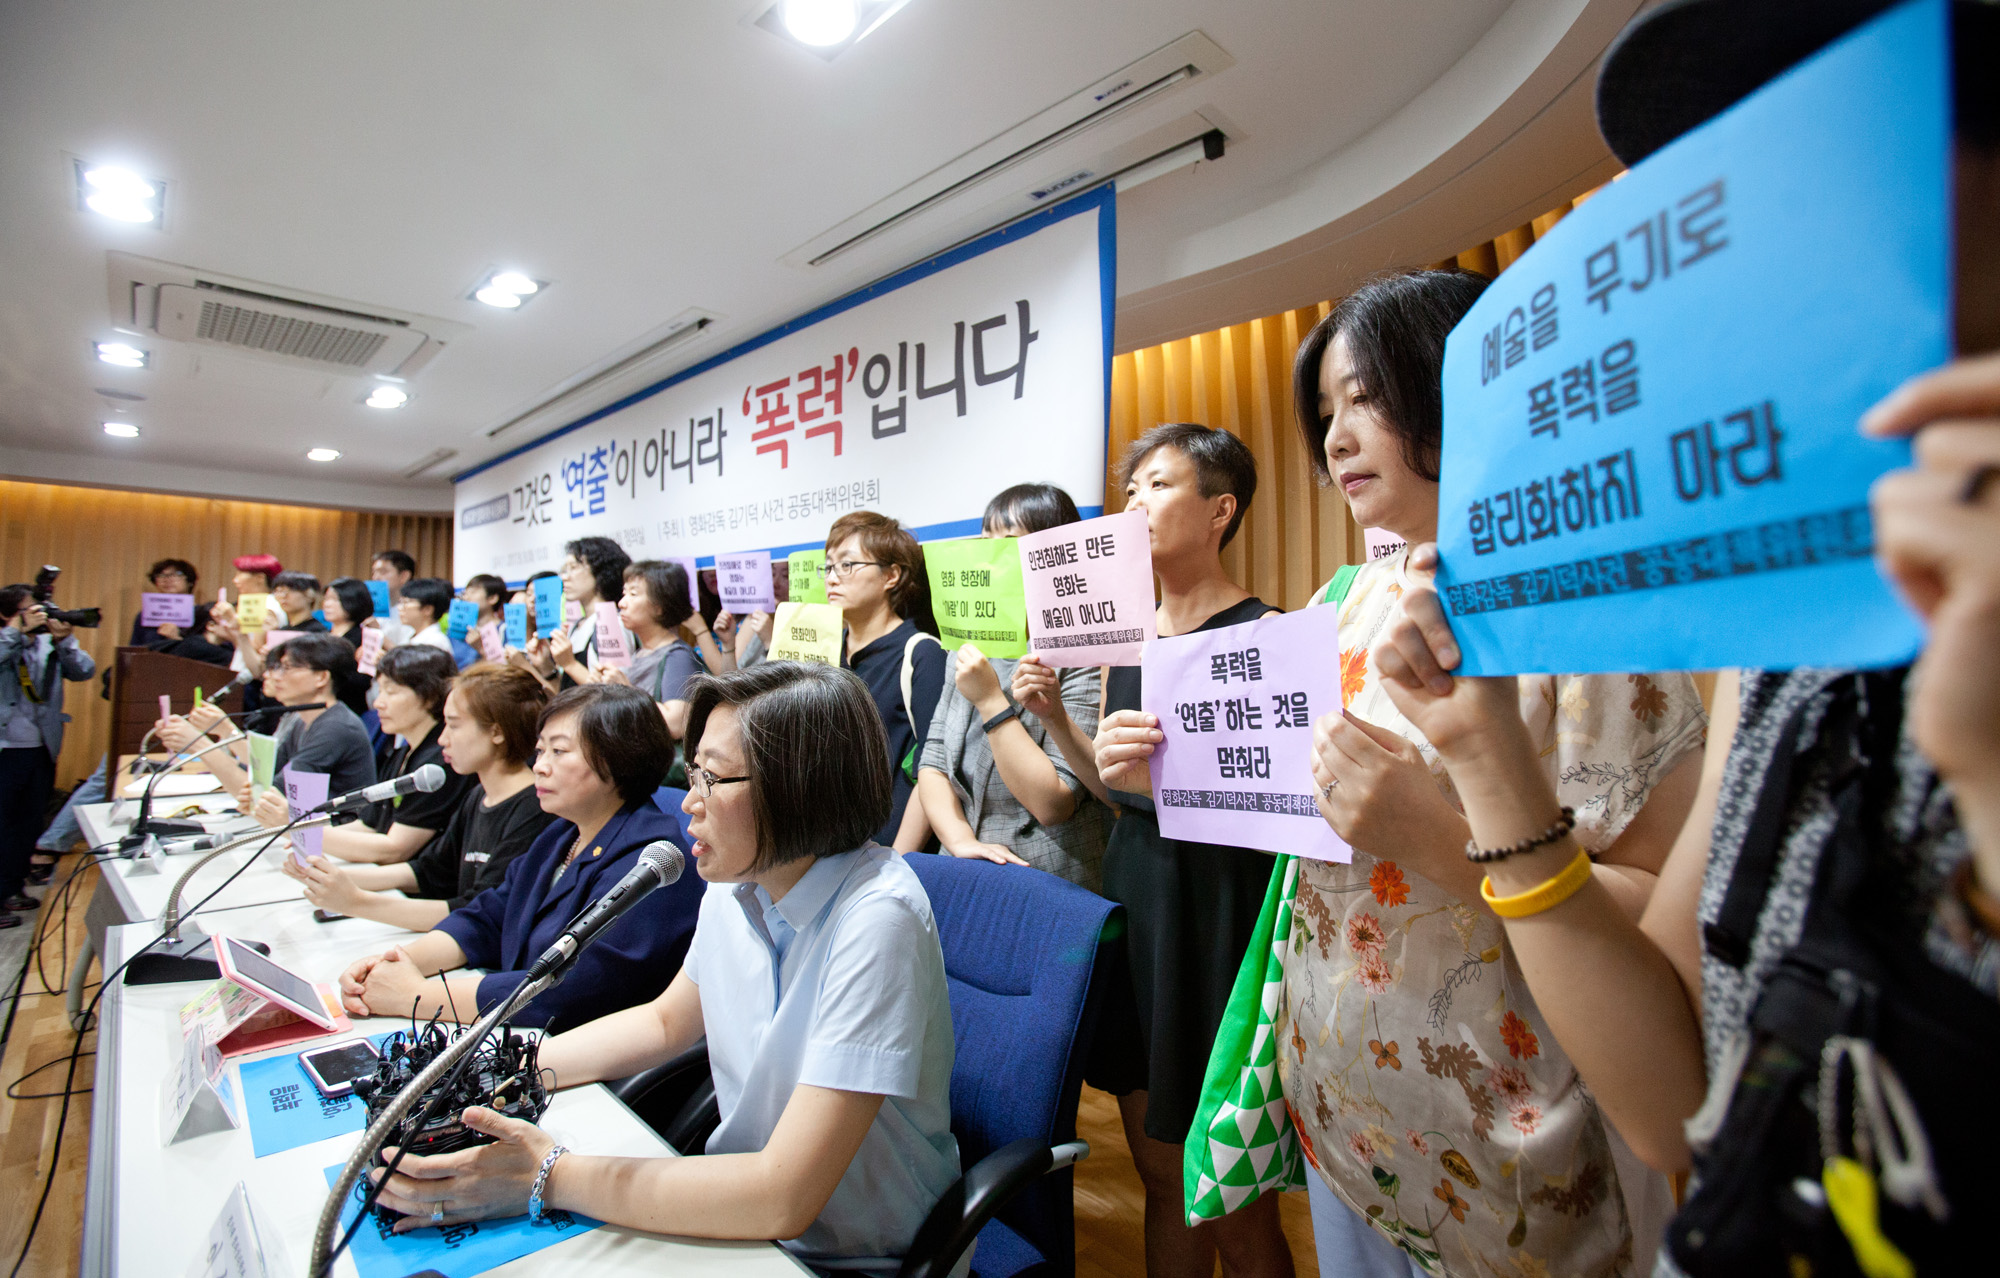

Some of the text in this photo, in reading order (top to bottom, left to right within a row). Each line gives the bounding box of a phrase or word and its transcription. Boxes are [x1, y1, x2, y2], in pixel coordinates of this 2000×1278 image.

[1481, 176, 1731, 387] 예술을 무기로
[1527, 337, 1641, 439] 폭력을
[512, 473, 553, 528] 그것은
[561, 438, 636, 520] ‘연출’이
[643, 407, 727, 491] 아니라
[742, 299, 1040, 469] ‘폭력’입니다
[1467, 400, 1786, 556] 합리화하지 마라
[688, 509, 725, 537] 영화감독
[728, 500, 759, 531] 김기덕
[761, 498, 784, 523] 사건
[787, 478, 881, 520] 공동대책위원회
[1028, 534, 1115, 571] 인권침해로 만든
[941, 570, 990, 587] 영화 현장에
[1052, 573, 1088, 597] 영화는
[1447, 577, 1514, 616] 영화감독
[1519, 556, 1632, 604] 김기덕사건
[975, 600, 996, 618] 있다
[1042, 600, 1116, 629] 예술이 아니다
[791, 626, 818, 642] 영화인의
[1091, 628, 1144, 645] 공동대책위원회
[1210, 647, 1263, 684] 폭력을
[1174, 691, 1309, 733] ‘연출’하는 것을
[1217, 746, 1271, 779] 멈춰라
[1162, 789, 1321, 817] 영화감독 김기덕사건 공동대책위원
